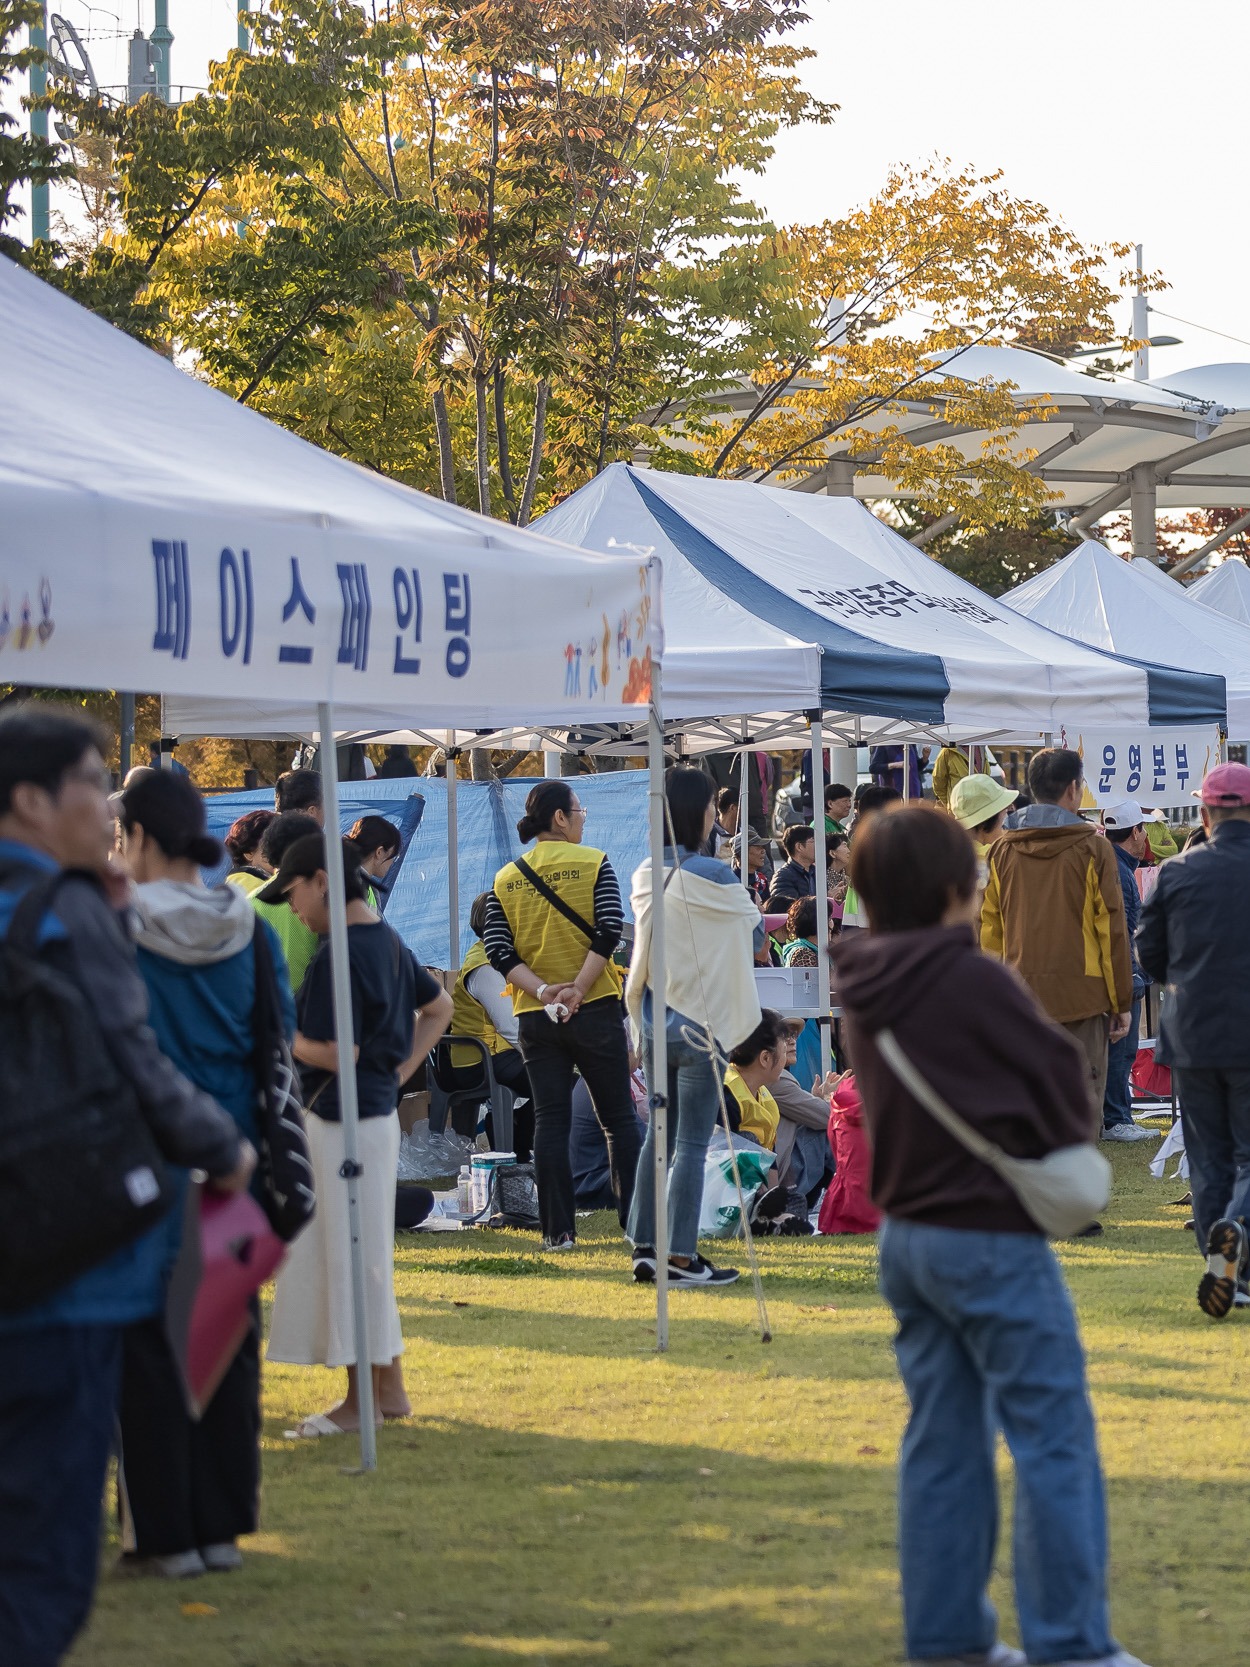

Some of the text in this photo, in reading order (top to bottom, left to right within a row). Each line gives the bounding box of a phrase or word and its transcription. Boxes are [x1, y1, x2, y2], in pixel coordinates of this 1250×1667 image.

[151, 538, 471, 679] 페이스페인팅
[1099, 744, 1189, 792] 운영본부
[541, 870, 580, 883] 장협의회
